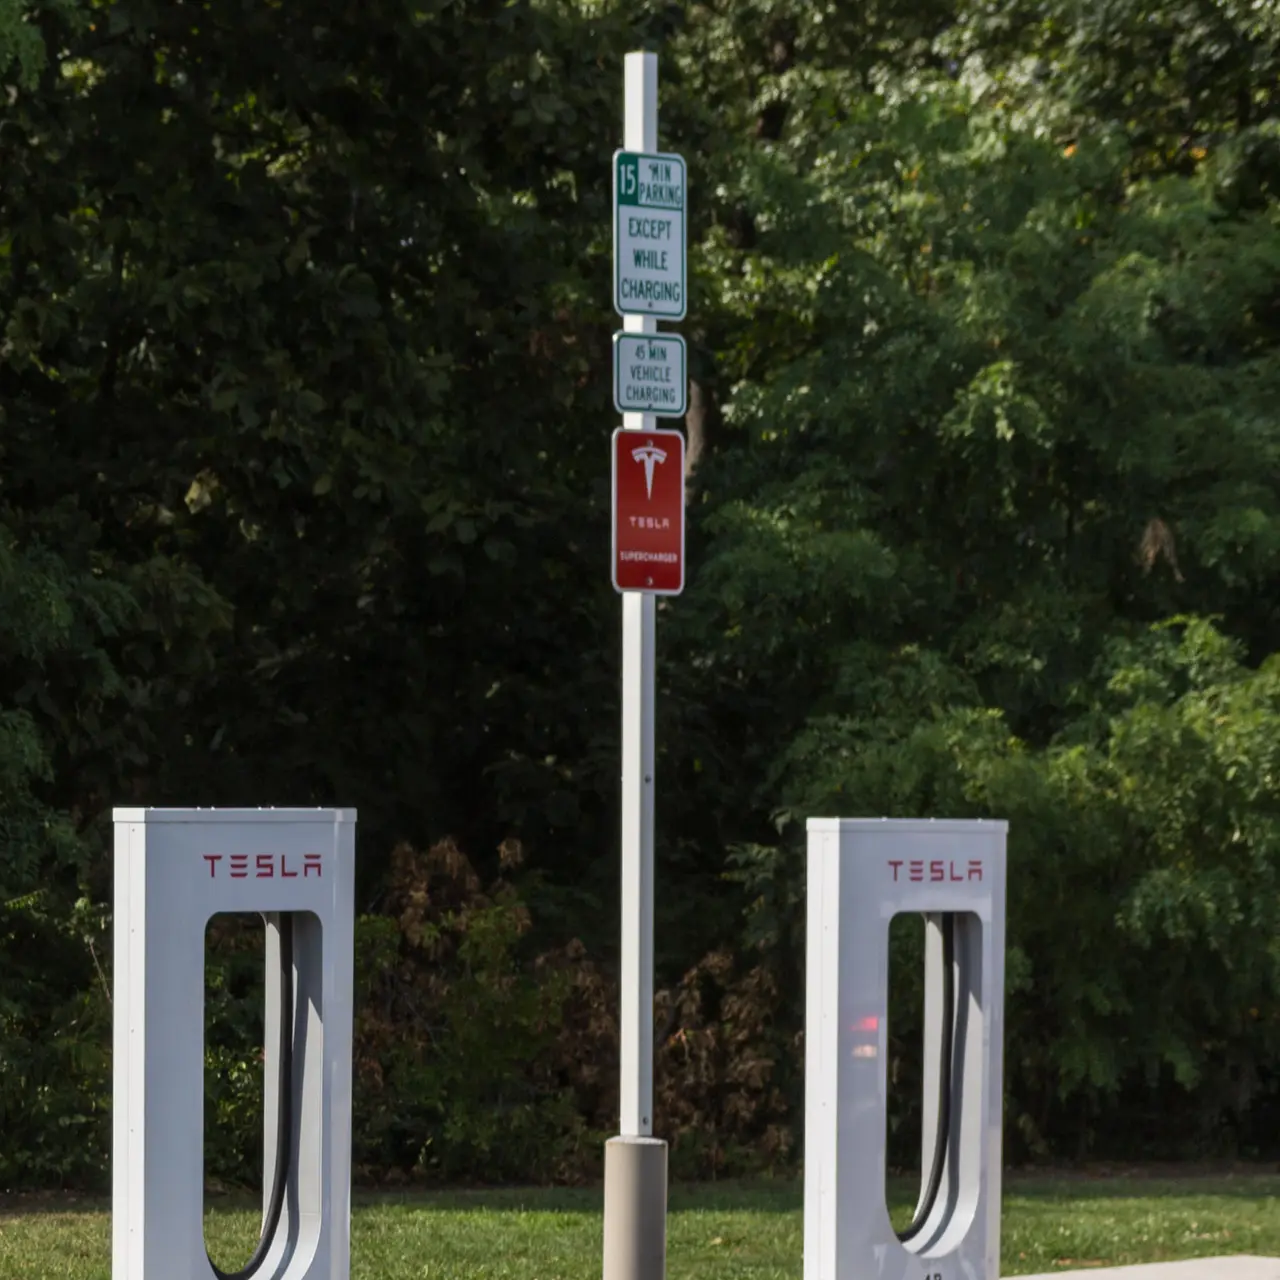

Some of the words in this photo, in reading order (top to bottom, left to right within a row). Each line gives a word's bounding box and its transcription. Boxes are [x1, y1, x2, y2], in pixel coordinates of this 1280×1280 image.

[619, 164, 636, 195] 15
[651, 163, 671, 182] MIN
[640, 182, 682, 206] PARKING
[628, 217, 672, 241] EXCEPT
[633, 248, 668, 271] WHILE
[621, 278, 680, 302] CHARGING
[648, 344, 667, 361] MIN
[630, 365, 671, 383] VEHICLE
[626, 385, 676, 404] CHARGING
[629, 516, 670, 530] TESLA
[620, 551, 678, 563] SUPERCHARGER
[202, 854, 322, 878] TESLA
[887, 860, 983, 882] TESLA
